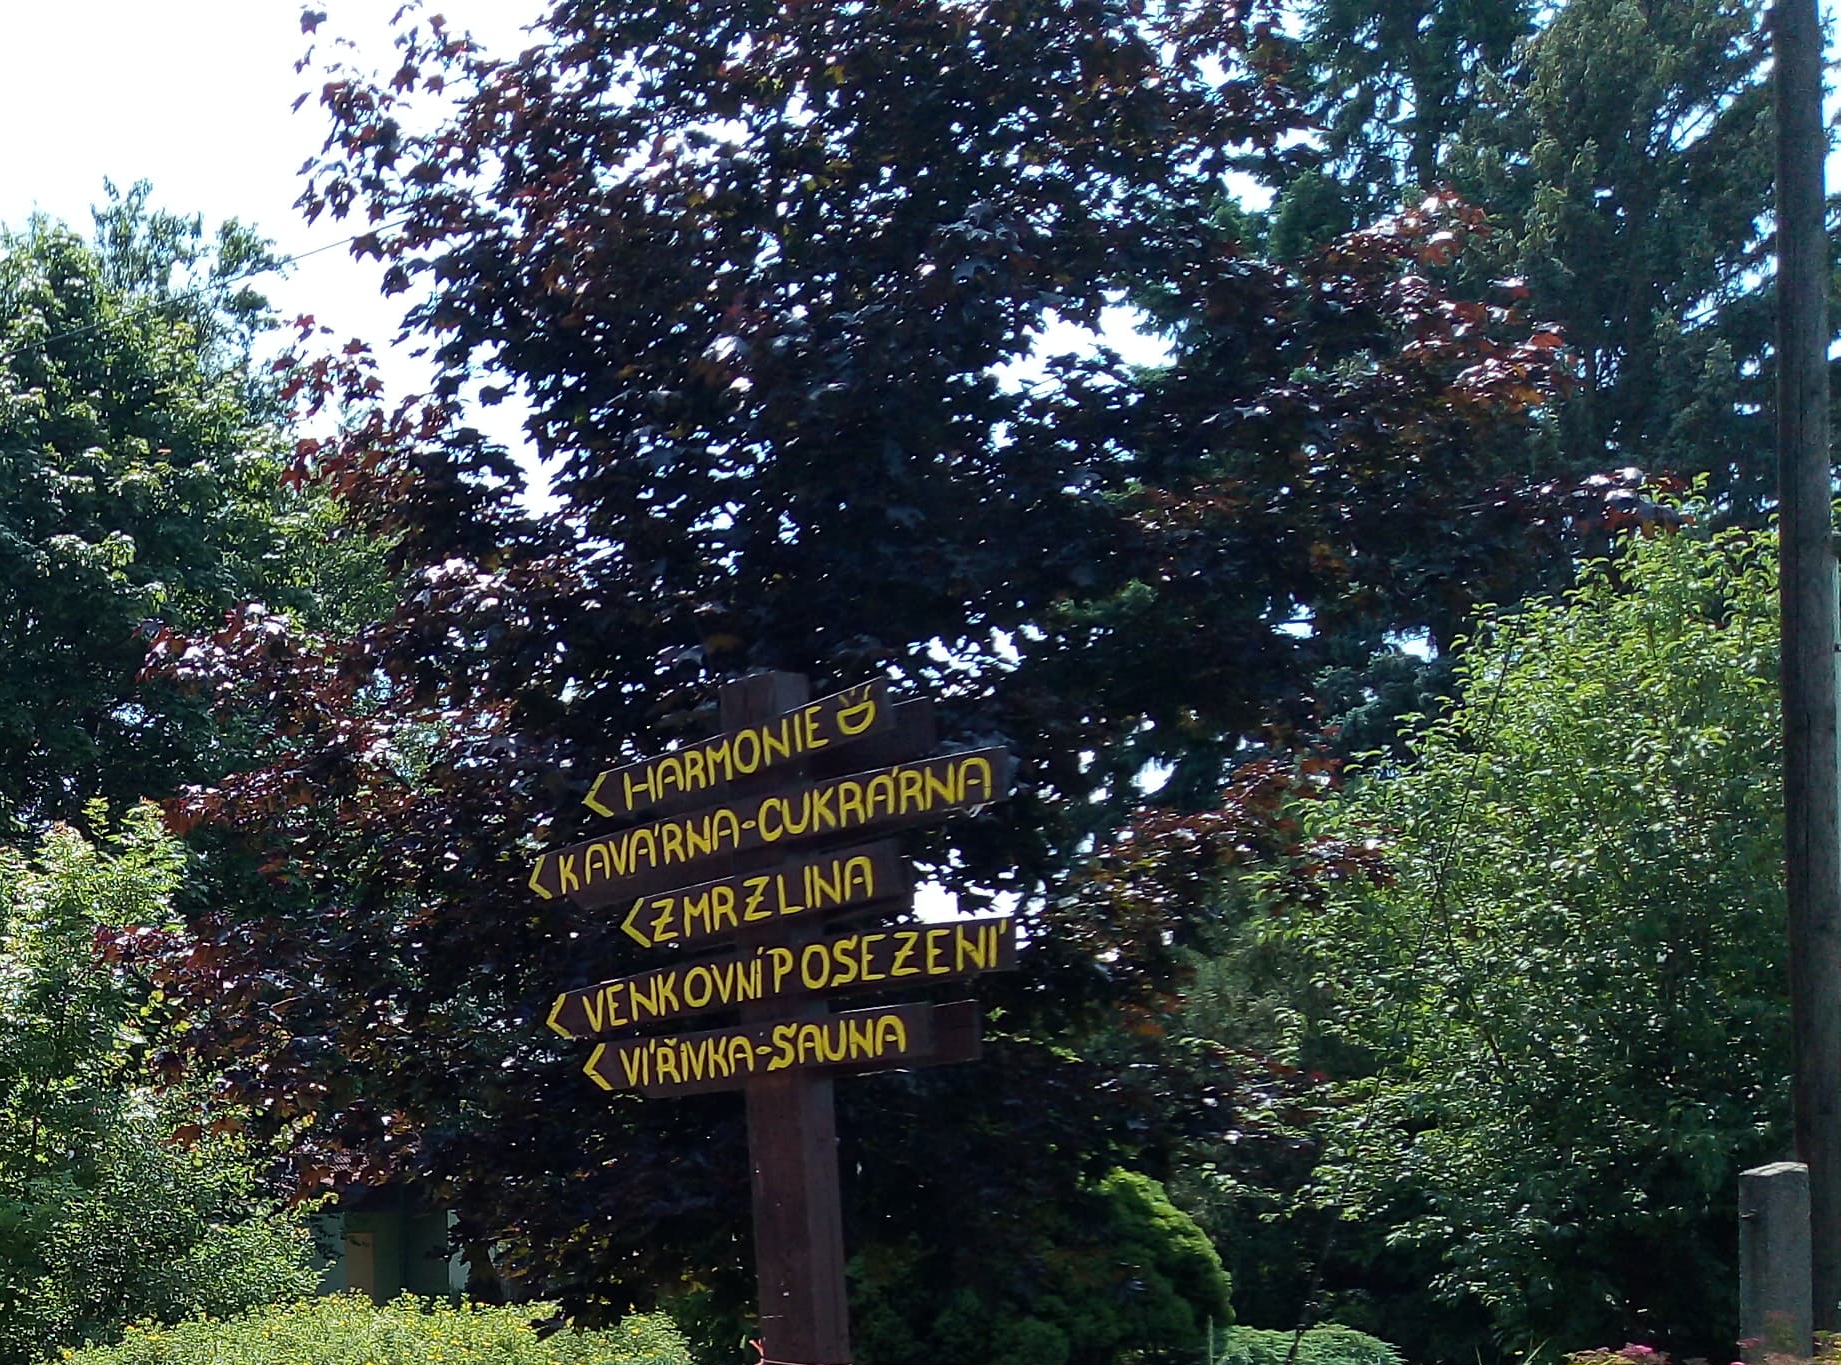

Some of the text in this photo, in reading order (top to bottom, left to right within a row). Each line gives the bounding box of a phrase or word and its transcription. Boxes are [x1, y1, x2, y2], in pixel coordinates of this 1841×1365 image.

[623, 705, 830, 810] HARMONIE
[649, 855, 874, 943] ZMRZLINA
[581, 919, 1007, 1034] VENKOVNÍ POSEZENÍ
